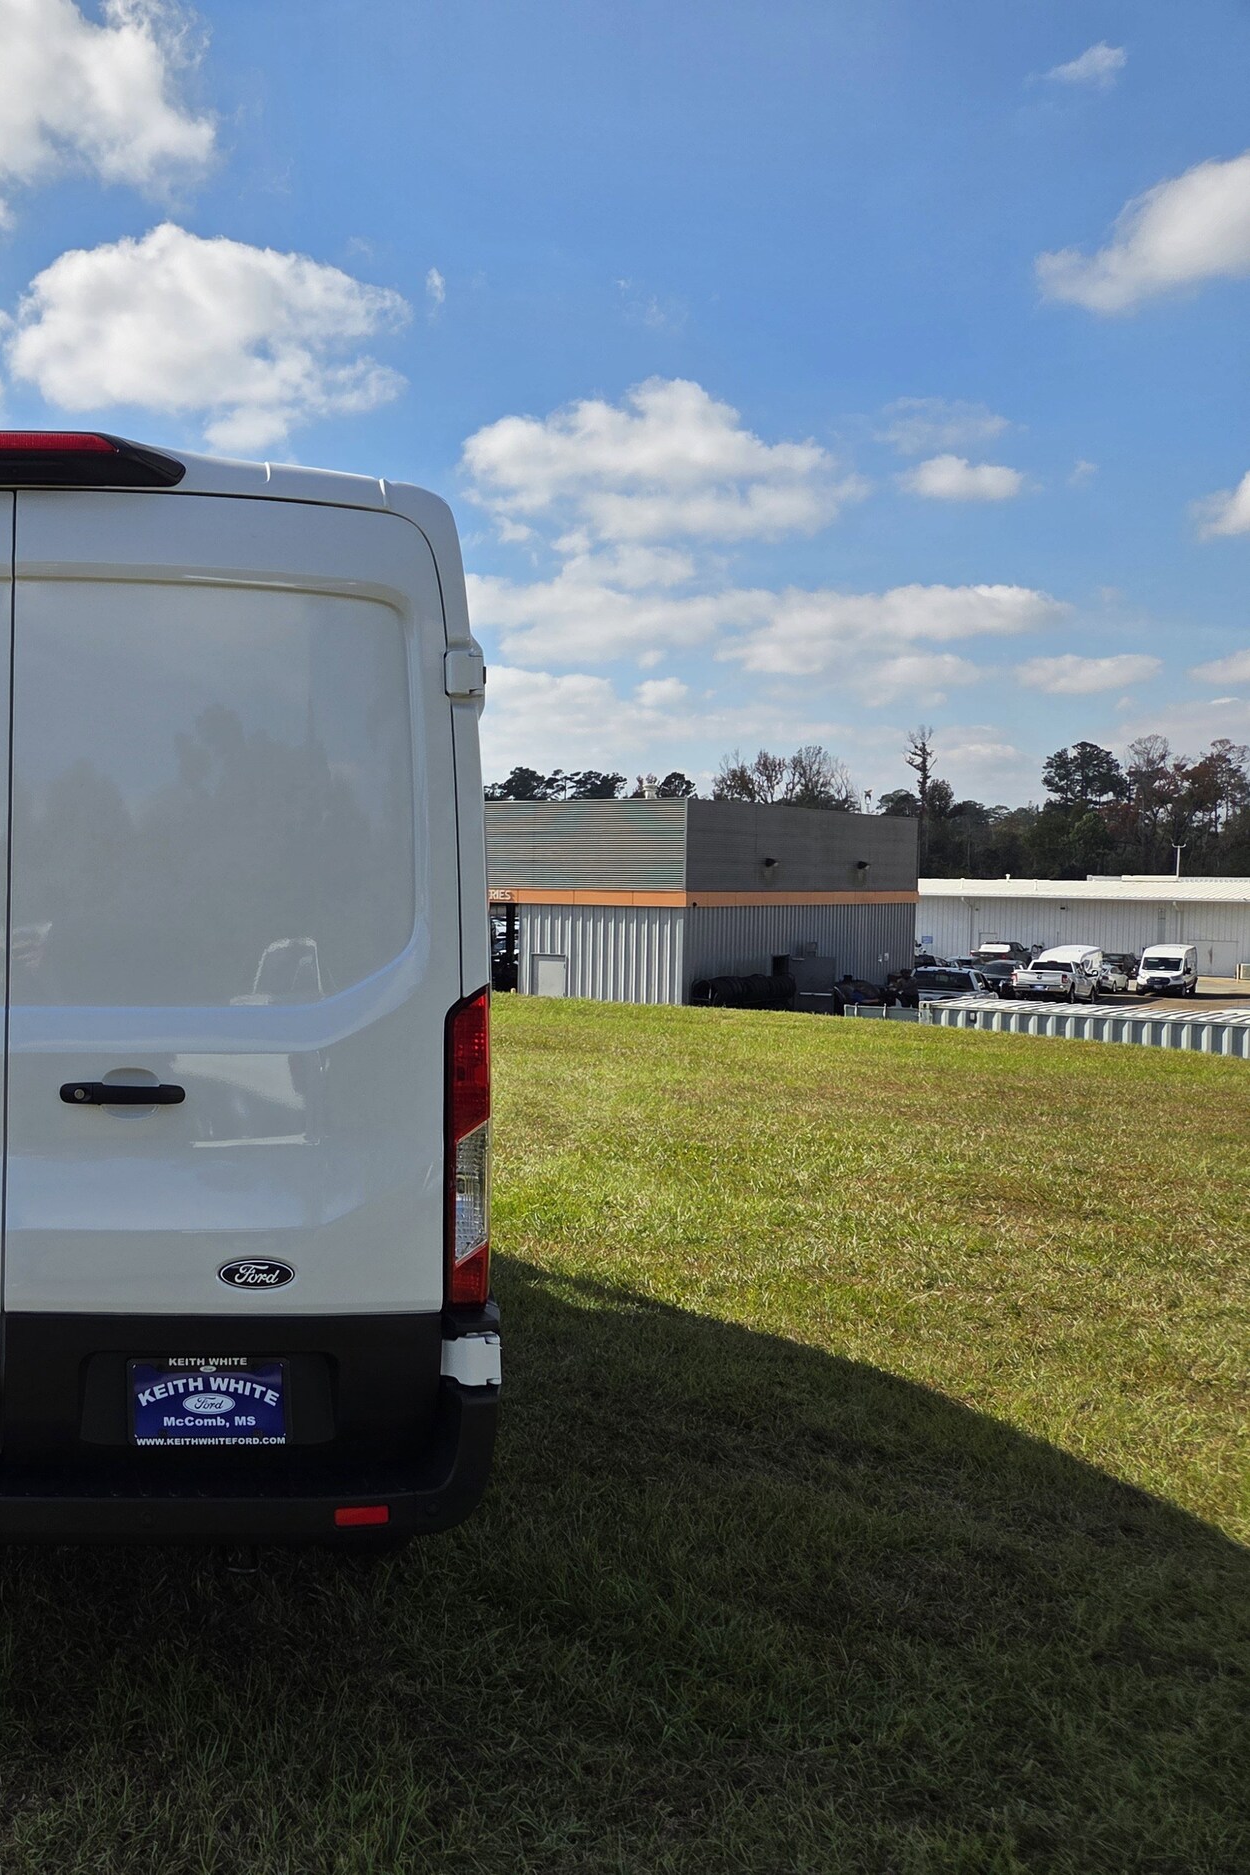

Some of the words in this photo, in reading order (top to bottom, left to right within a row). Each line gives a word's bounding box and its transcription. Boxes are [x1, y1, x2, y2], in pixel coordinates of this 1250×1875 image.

[488, 889, 512, 900] RIES
[234, 1264, 281, 1284] Ford
[168, 1357, 206, 1367] KEITH
[208, 1357, 248, 1366] WHITE
[137, 1376, 204, 1407] KEITH
[209, 1376, 280, 1407] WHITE
[163, 1416, 230, 1428] McComb,
[234, 1416, 256, 1426] MS
[136, 1436, 286, 1446] WWW.KEITHWHITEFORD.COM
